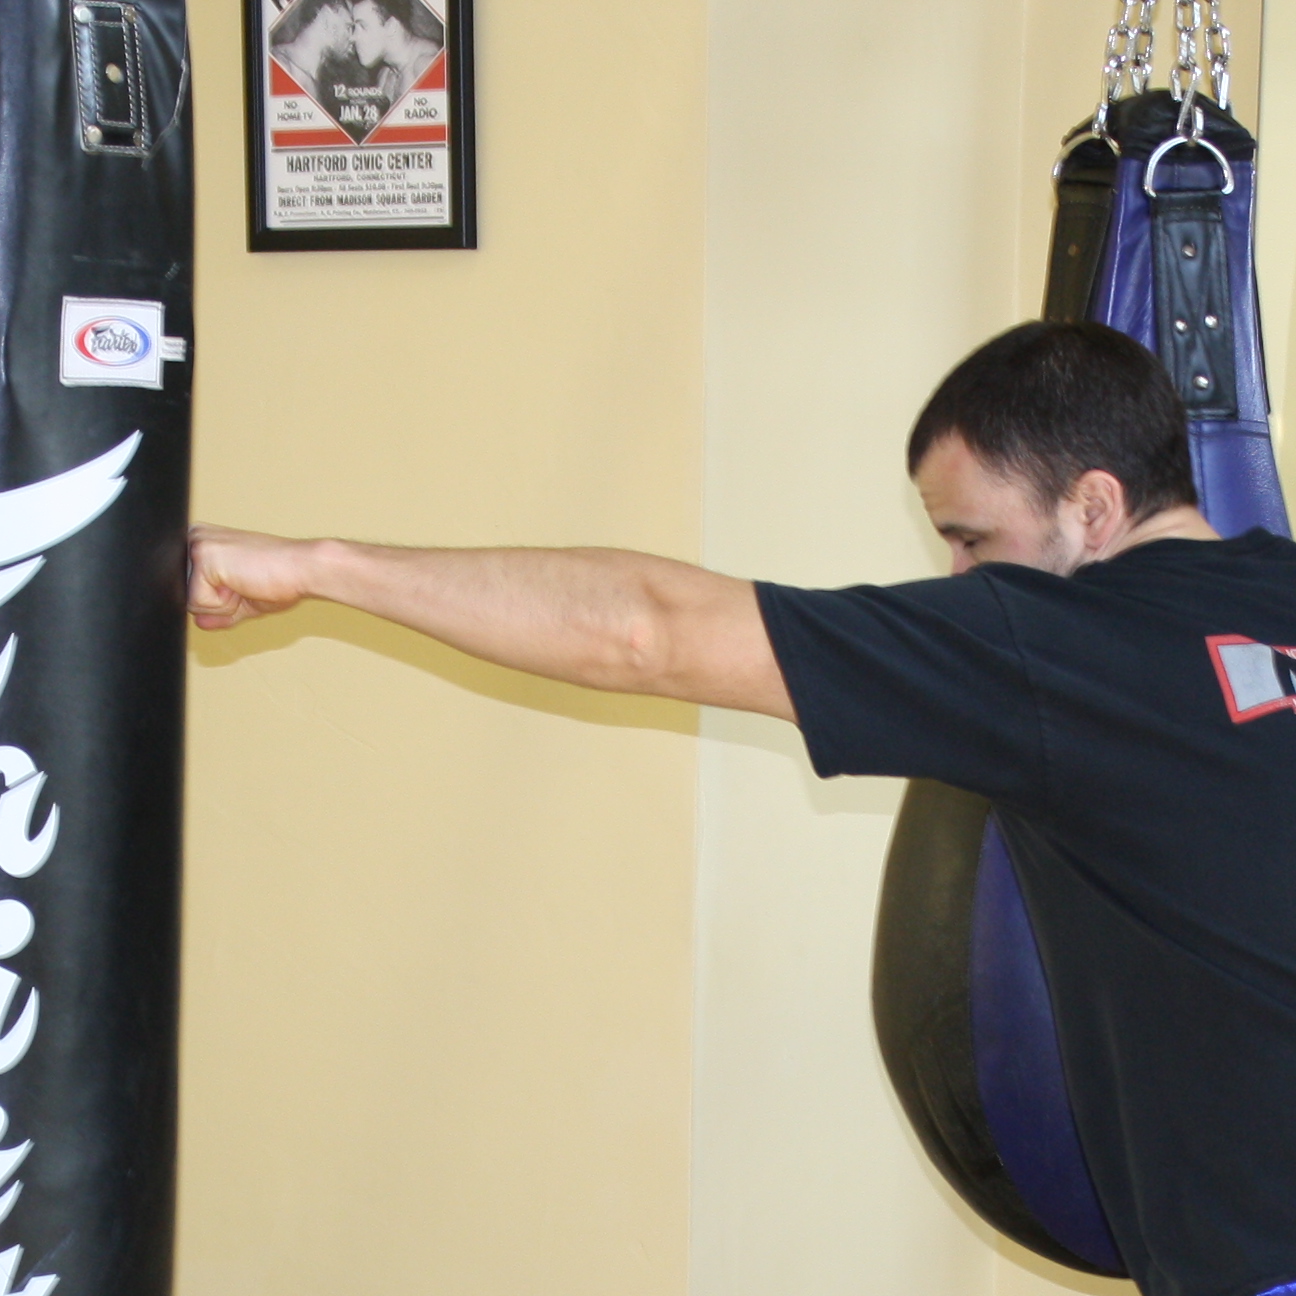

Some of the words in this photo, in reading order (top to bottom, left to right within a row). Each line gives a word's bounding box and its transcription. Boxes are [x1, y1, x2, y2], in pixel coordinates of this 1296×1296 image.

[333, 84, 346, 98] 12
[284, 101, 298, 110] NO
[414, 97, 428, 106] NO
[277, 112, 302, 121] HOME
[302, 111, 314, 120] TV
[339, 105, 362, 121] JAN.
[363, 104, 378, 122] 28
[404, 107, 437, 120] RADIO
[286, 154, 347, 173] HARTFORD
[352, 153, 383, 171] CIVIC
[387, 152, 433, 170] CENTER
[278, 196, 306, 208] DIRECT
[310, 195, 333, 207] FROM
[336, 193, 372, 206] MADISON
[376, 192, 406, 207] SQUARE
[411, 191, 442, 204] GARDEN
